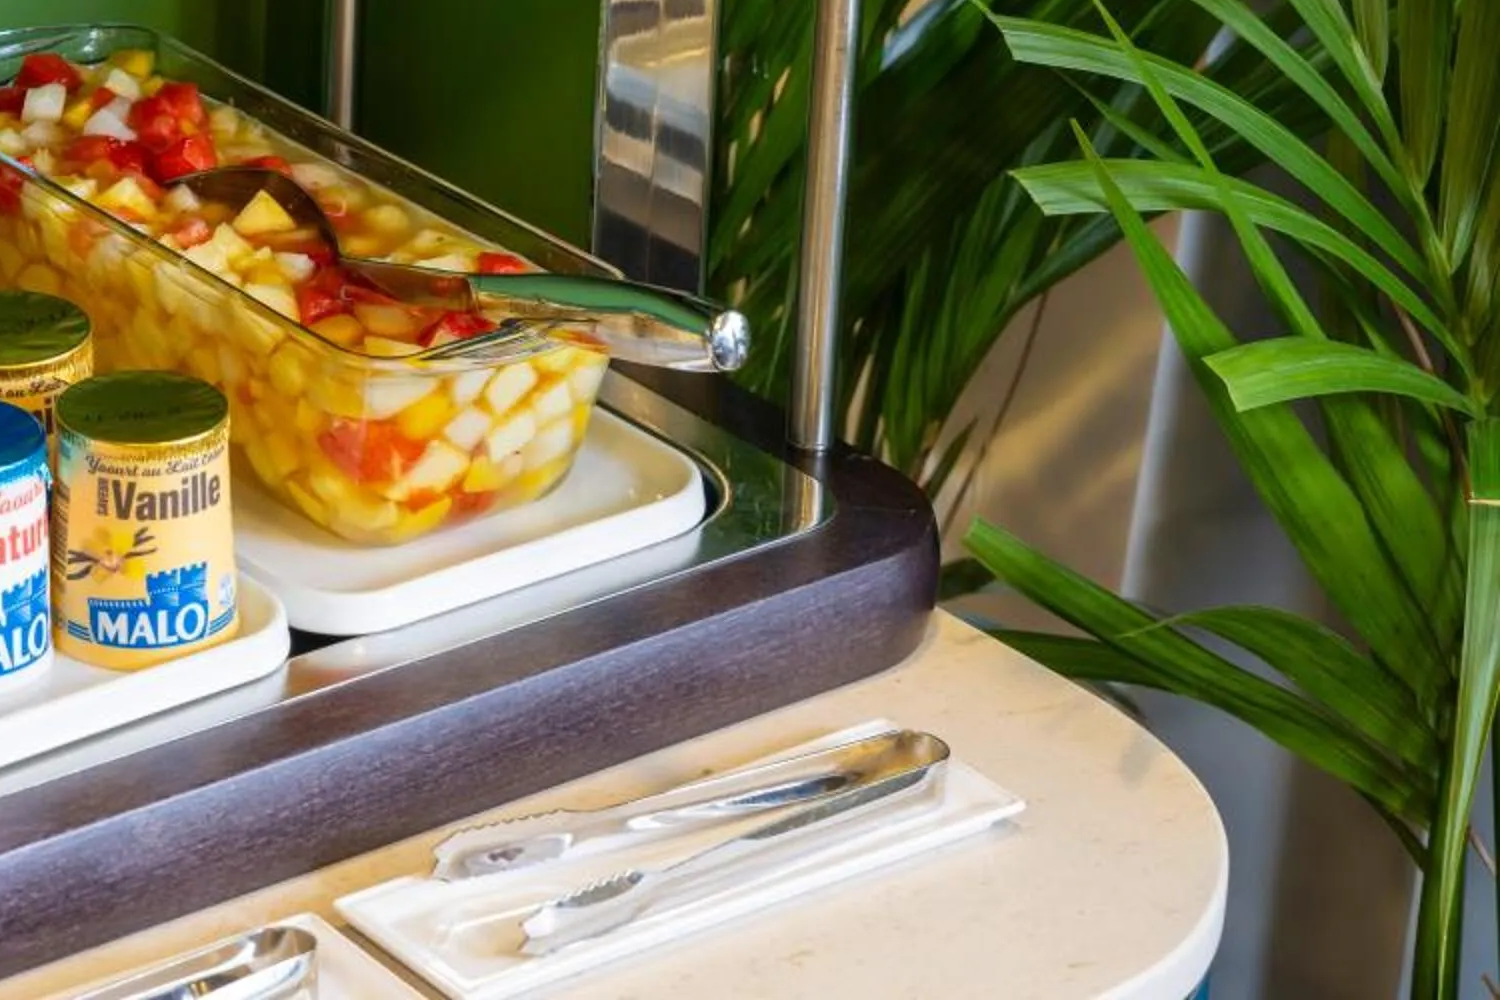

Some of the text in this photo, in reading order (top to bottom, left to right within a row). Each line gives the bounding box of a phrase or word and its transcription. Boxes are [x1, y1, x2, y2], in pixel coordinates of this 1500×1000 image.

[85, 454, 139, 477] Yaourt
[141, 465, 162, 477] au
[111, 471, 221, 521] Vanille
[97, 601, 206, 646] MALO
